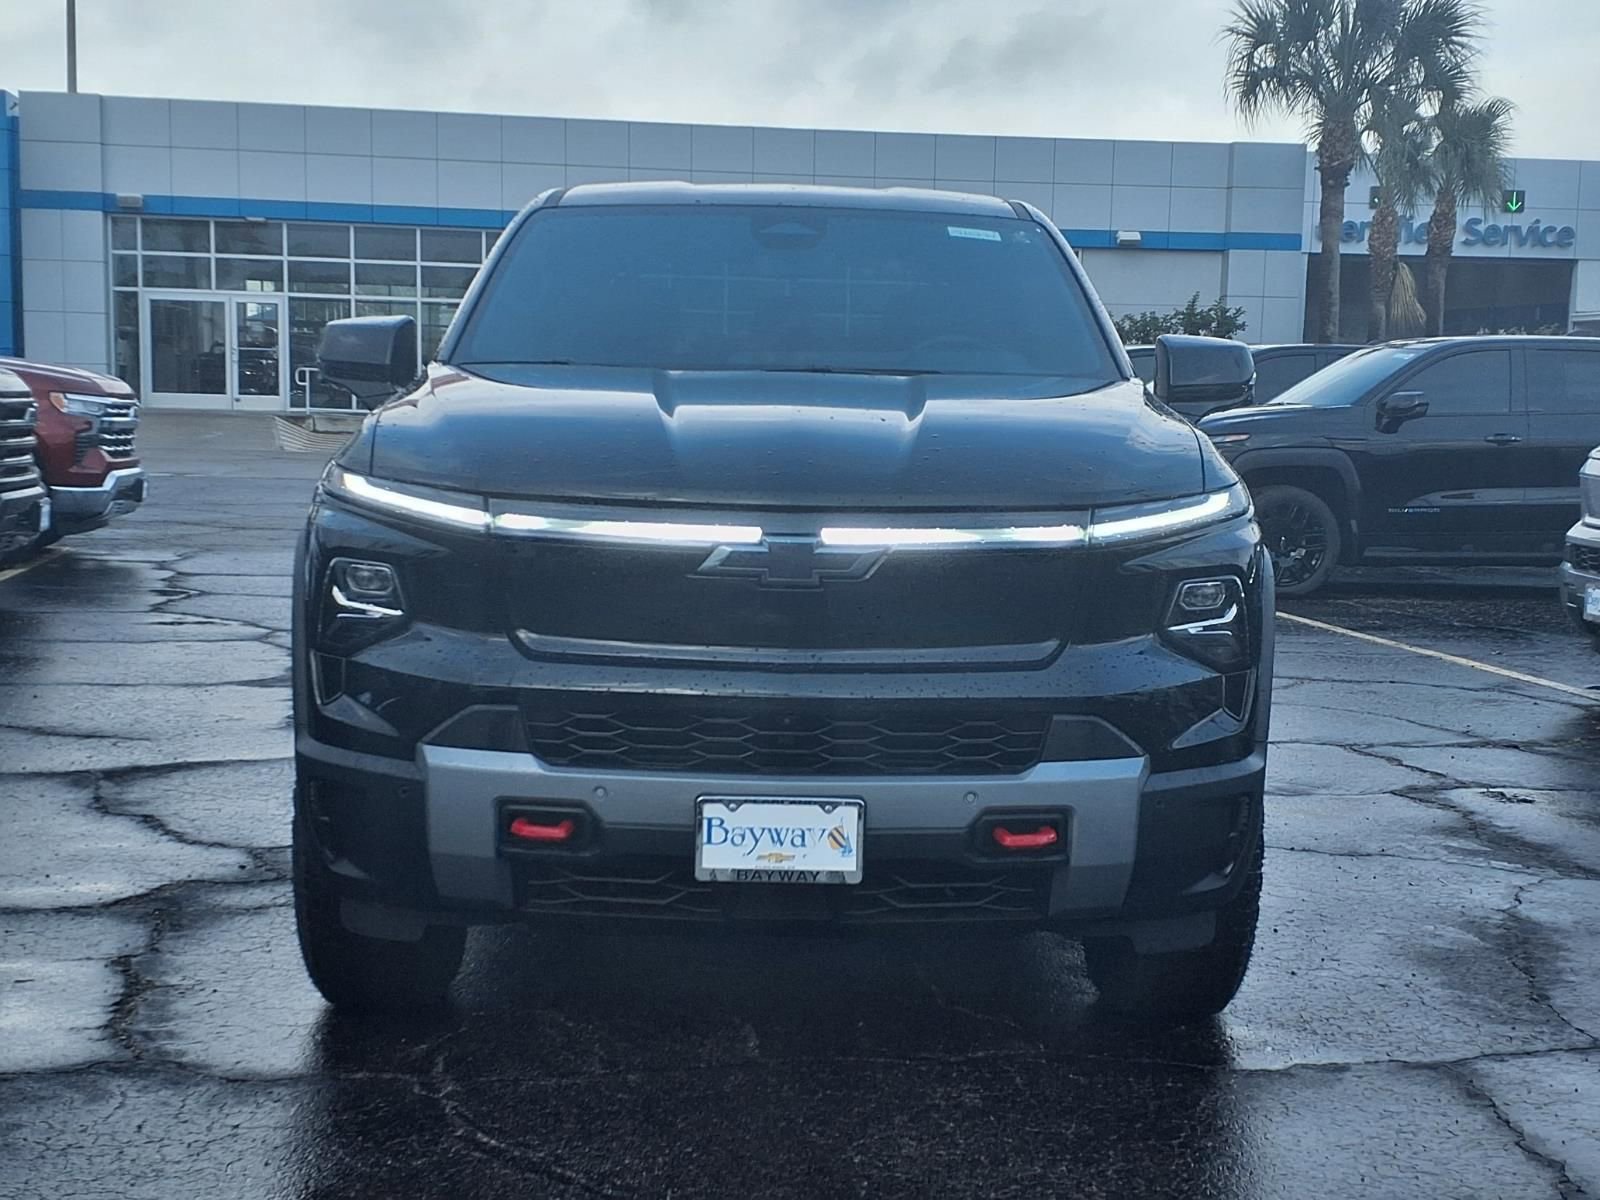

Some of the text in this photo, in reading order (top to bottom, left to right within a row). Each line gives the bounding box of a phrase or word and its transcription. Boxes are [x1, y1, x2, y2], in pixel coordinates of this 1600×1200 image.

[1461, 217, 1575, 248] Service
[703, 816, 828, 856] Bayway
[736, 870, 820, 882] BAYWAY
